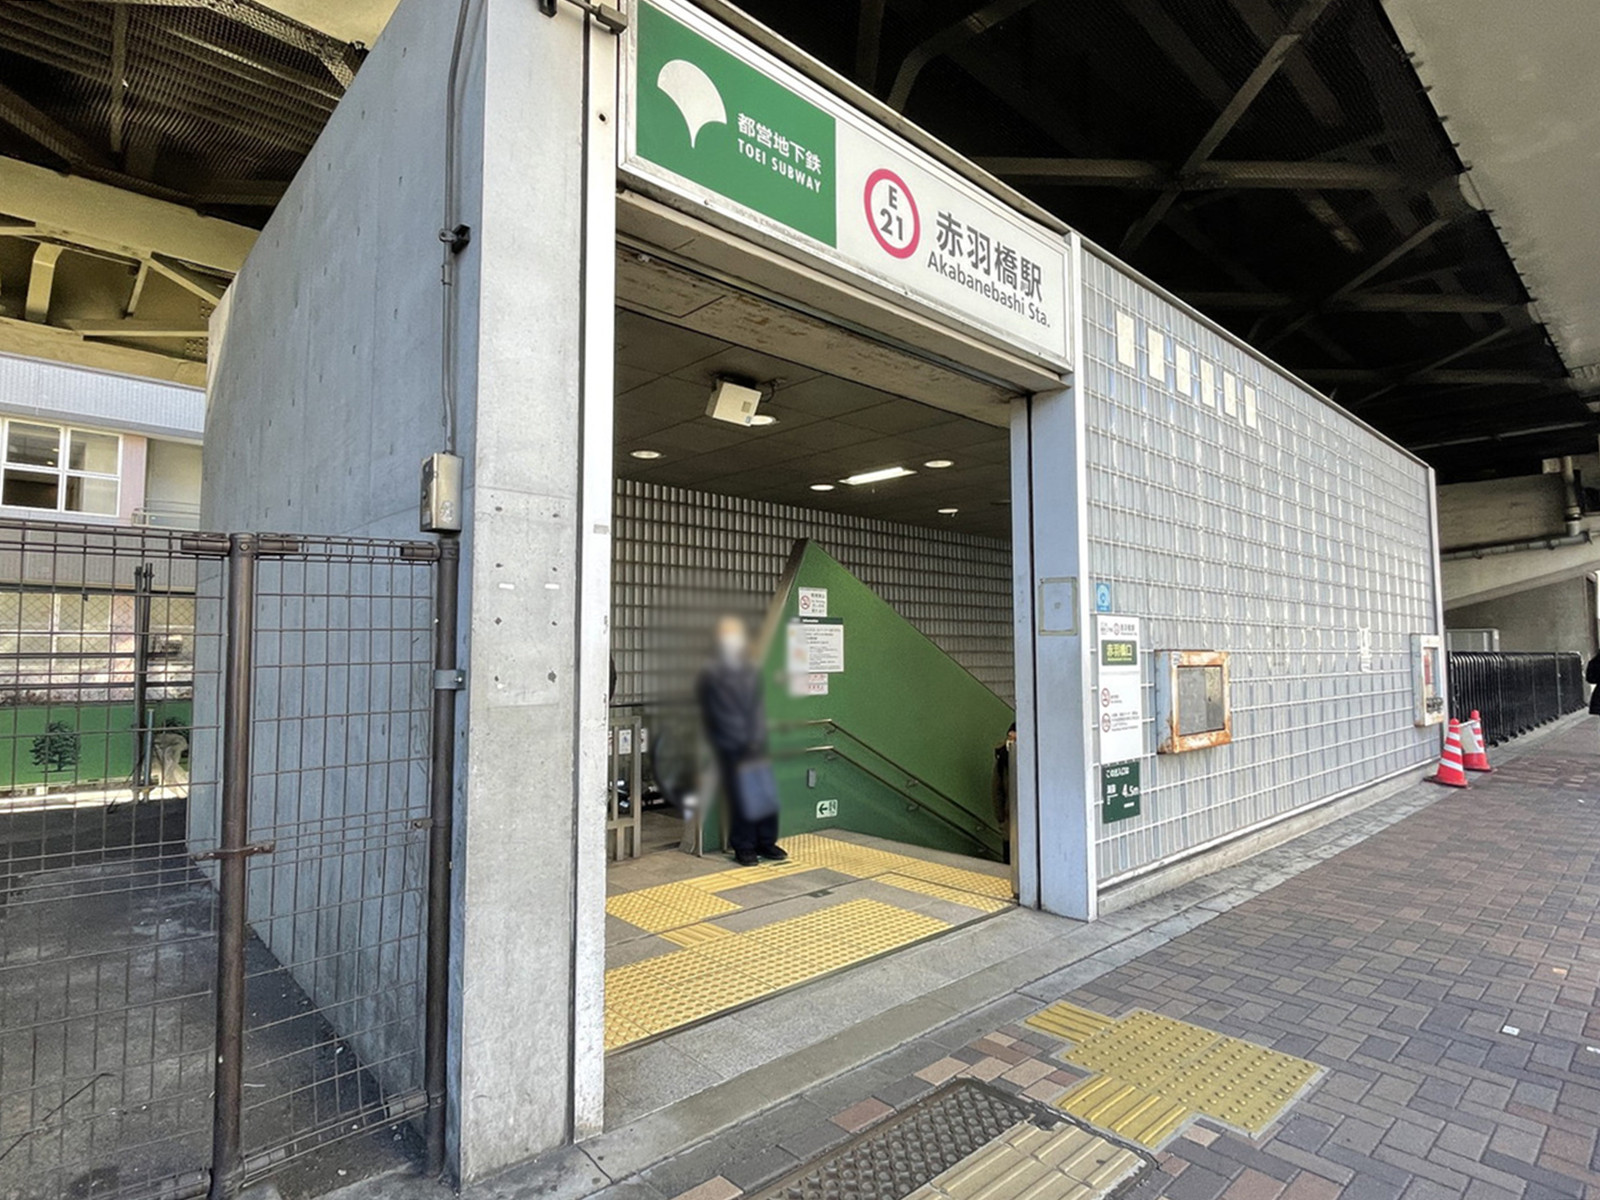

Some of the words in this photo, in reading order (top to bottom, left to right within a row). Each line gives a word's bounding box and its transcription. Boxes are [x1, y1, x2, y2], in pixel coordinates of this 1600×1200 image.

[738, 113, 821, 175] 都営地下鉄
[738, 138, 766, 165] TOEI
[771, 157, 821, 193] SUBWAY
[880, 208, 903, 241] 21
[888, 185, 898, 210] E
[936, 210, 1042, 302] 赤羽橋駅
[927, 250, 1025, 315] Akabanebashi
[1028, 302, 1051, 328] Sta.
